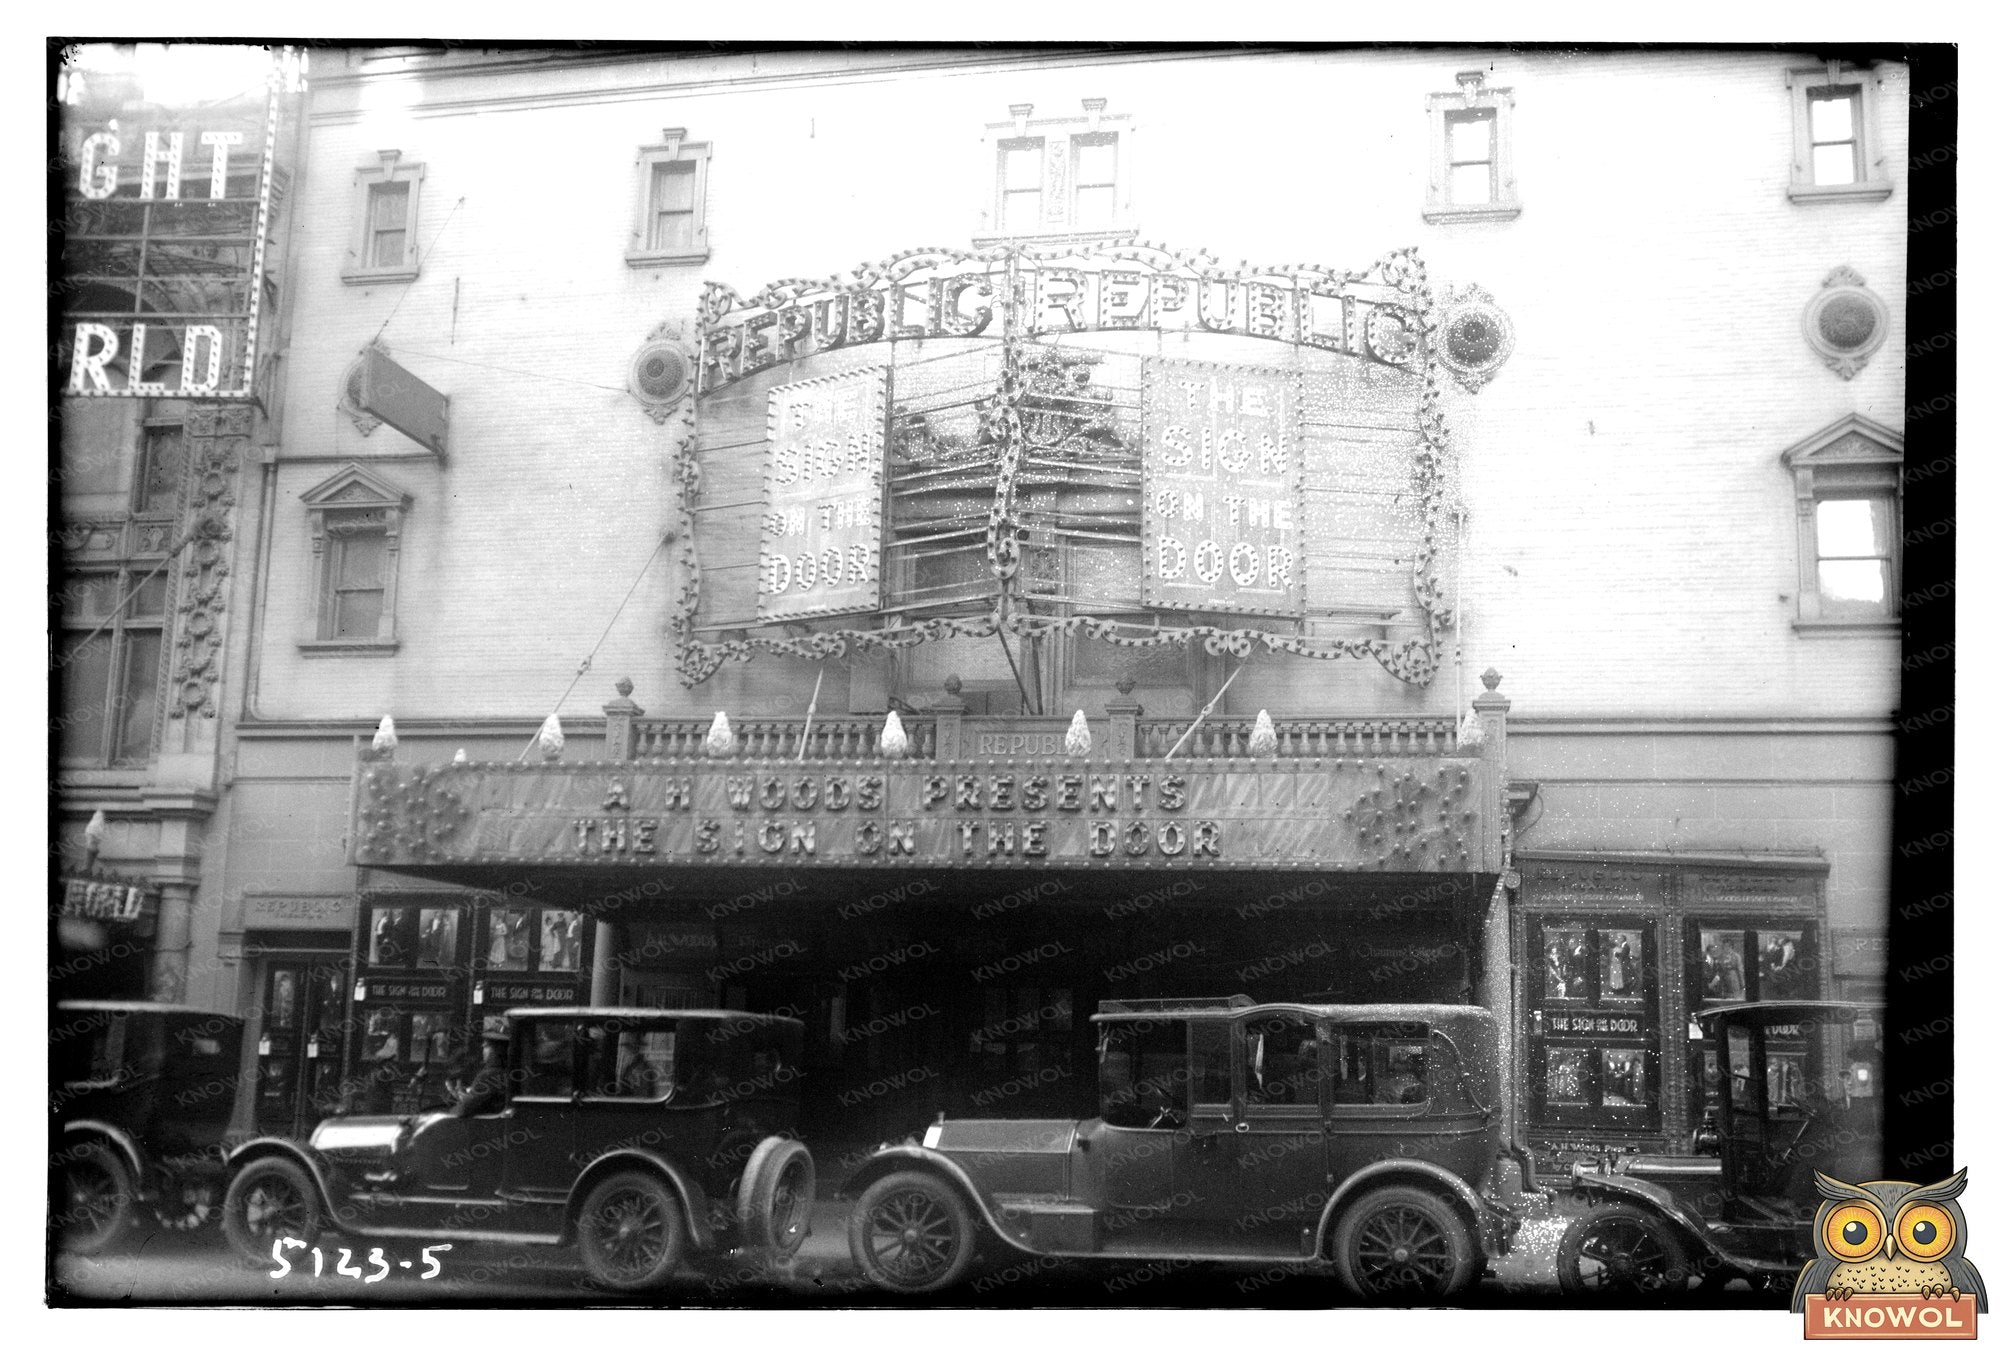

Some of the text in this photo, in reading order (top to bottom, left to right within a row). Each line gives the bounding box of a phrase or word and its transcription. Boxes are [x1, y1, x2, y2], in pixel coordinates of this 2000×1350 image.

[79, 131, 243, 199] GHT
[698, 273, 993, 393] REPUBLIC
[1035, 266, 1420, 366] REPUBLIC
[69, 323, 222, 391] RLD
[1179, 382, 1268, 416] THE
[775, 433, 871, 485] SIGN
[1161, 425, 1288, 474] SIGN
[768, 498, 871, 537] ON THE
[1156, 489, 1294, 529] ON THE
[768, 543, 870, 595] DOOR
[1157, 535, 1294, 587] DOOR
[980, 734, 1068, 755] REPUBL
[603, 774, 1186, 811] A H WOODS PRESENTS
[573, 819, 1221, 856] THE SIGN ON THE DOOR
[422, 986, 447, 997] DOOR
[546, 989, 574, 1000] DOOR
[1553, 1018, 1569, 1031] THE
[1572, 1018, 1595, 1031] SIGN
[1610, 1018, 1638, 1032] DOOR
[270, 1237, 453, 1283] 5123-5
